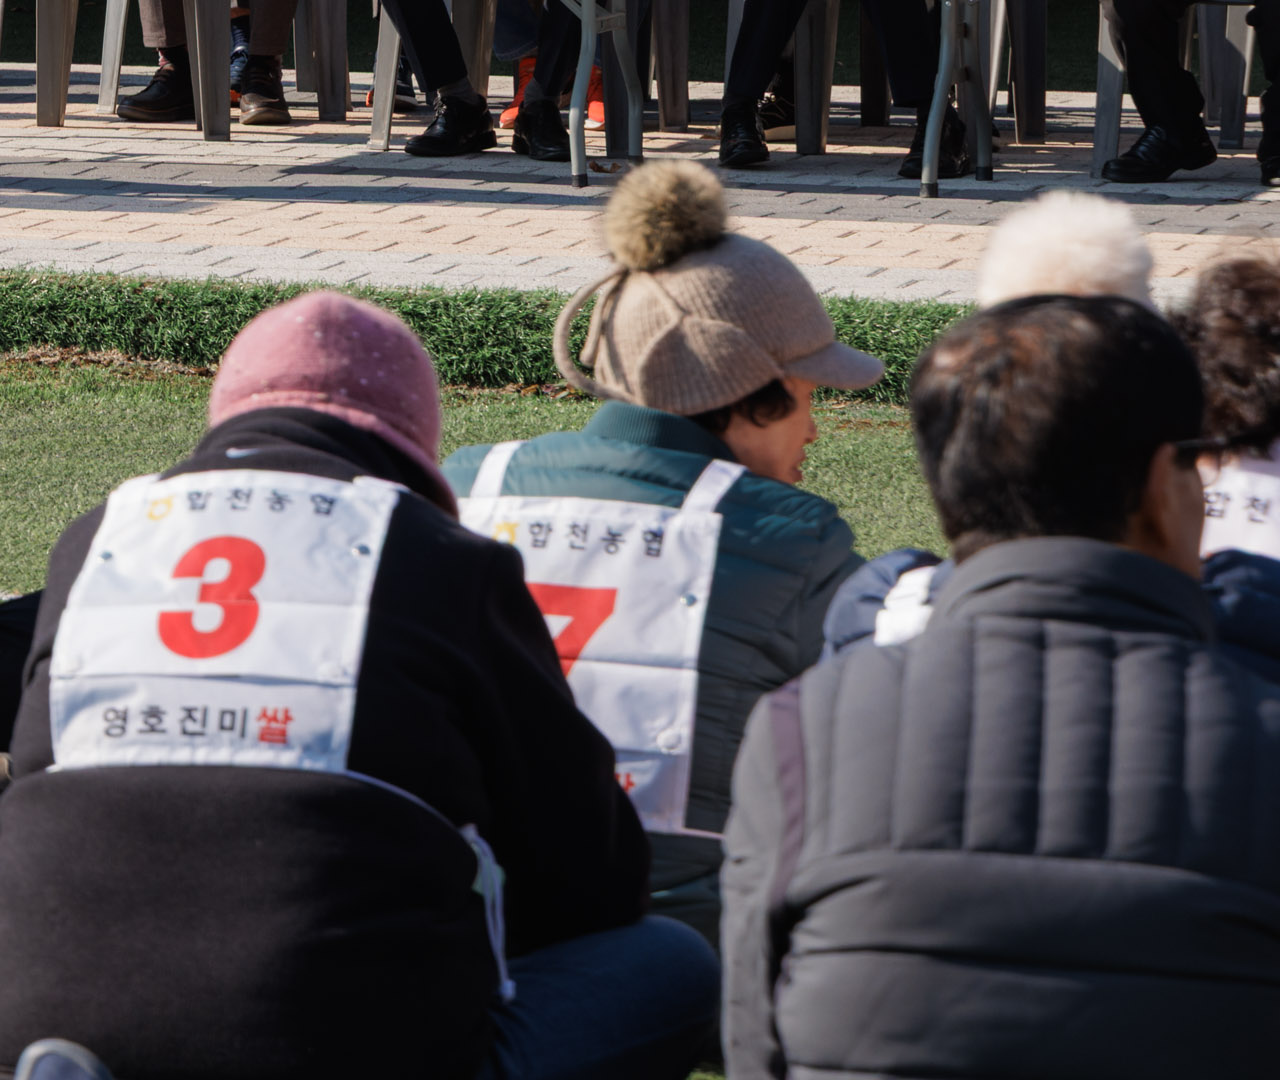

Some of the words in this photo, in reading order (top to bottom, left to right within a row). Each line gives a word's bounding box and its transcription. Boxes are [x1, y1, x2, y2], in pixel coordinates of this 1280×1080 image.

[186, 487, 339, 517] 합천농협
[528, 520, 665, 558] 합천농협
[157, 534, 267, 660] 3
[102, 704, 295, 745] 영호진미쌀
